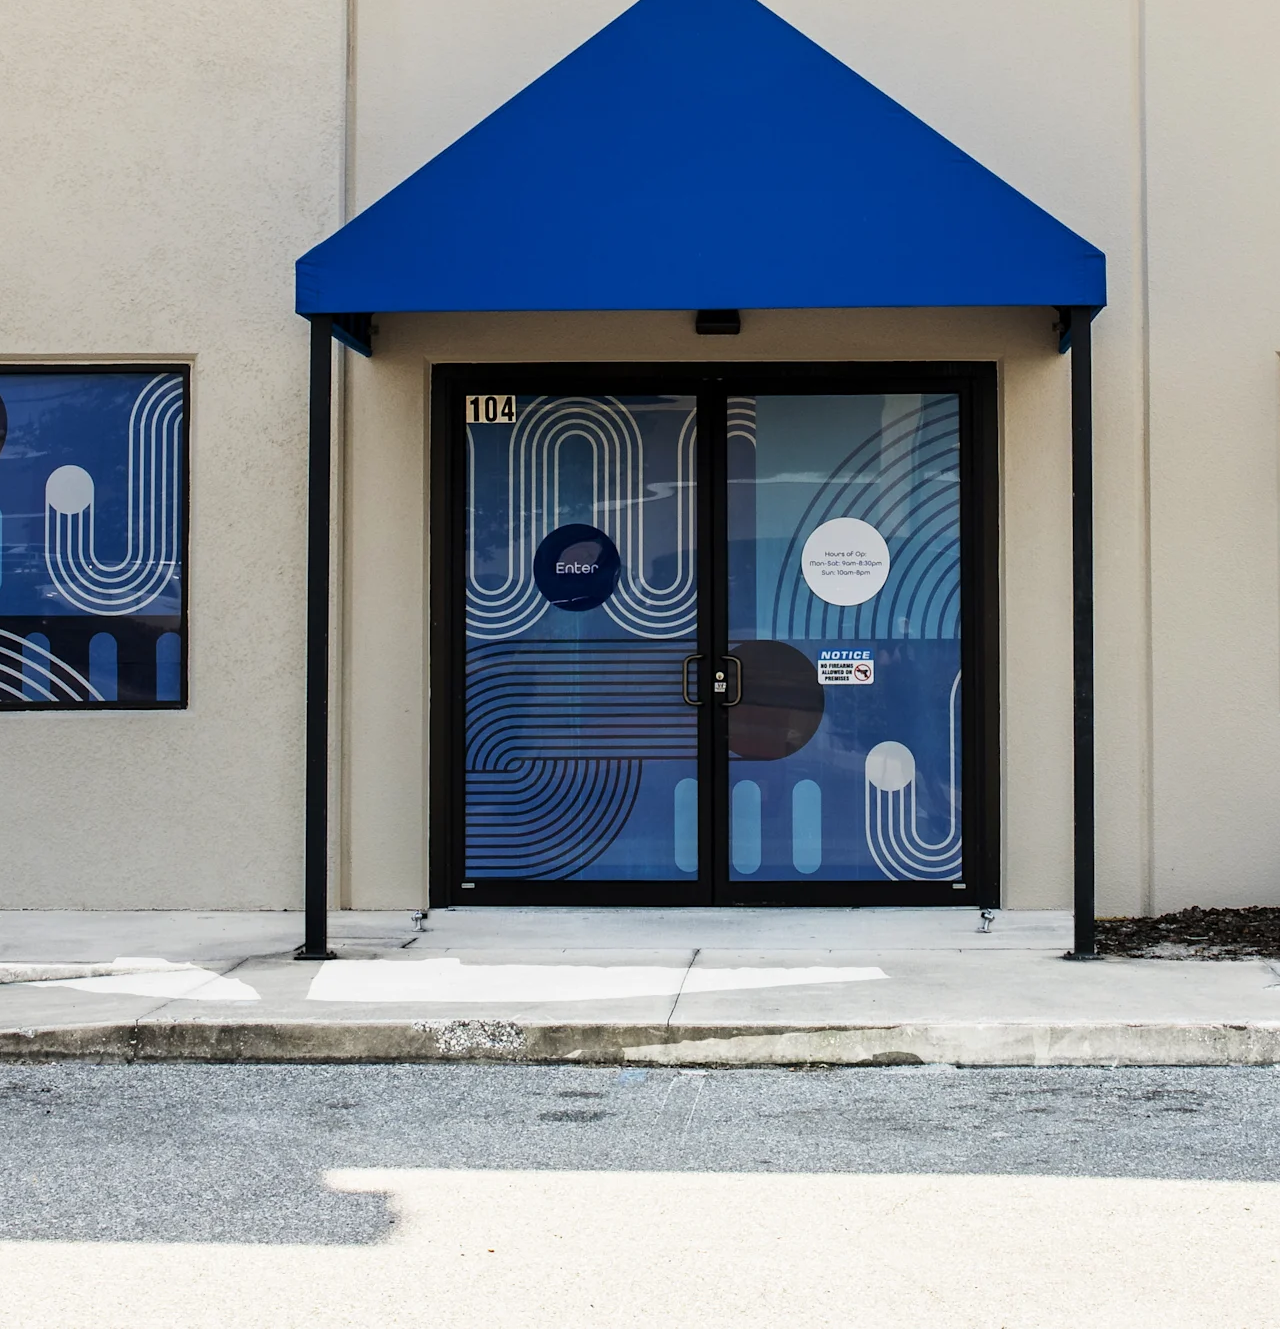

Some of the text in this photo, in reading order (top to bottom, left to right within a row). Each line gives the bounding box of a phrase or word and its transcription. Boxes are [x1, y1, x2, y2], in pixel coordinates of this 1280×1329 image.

[469, 396, 515, 422] 104
[556, 561, 599, 574] Enter
[821, 651, 870, 660] NOTICE
